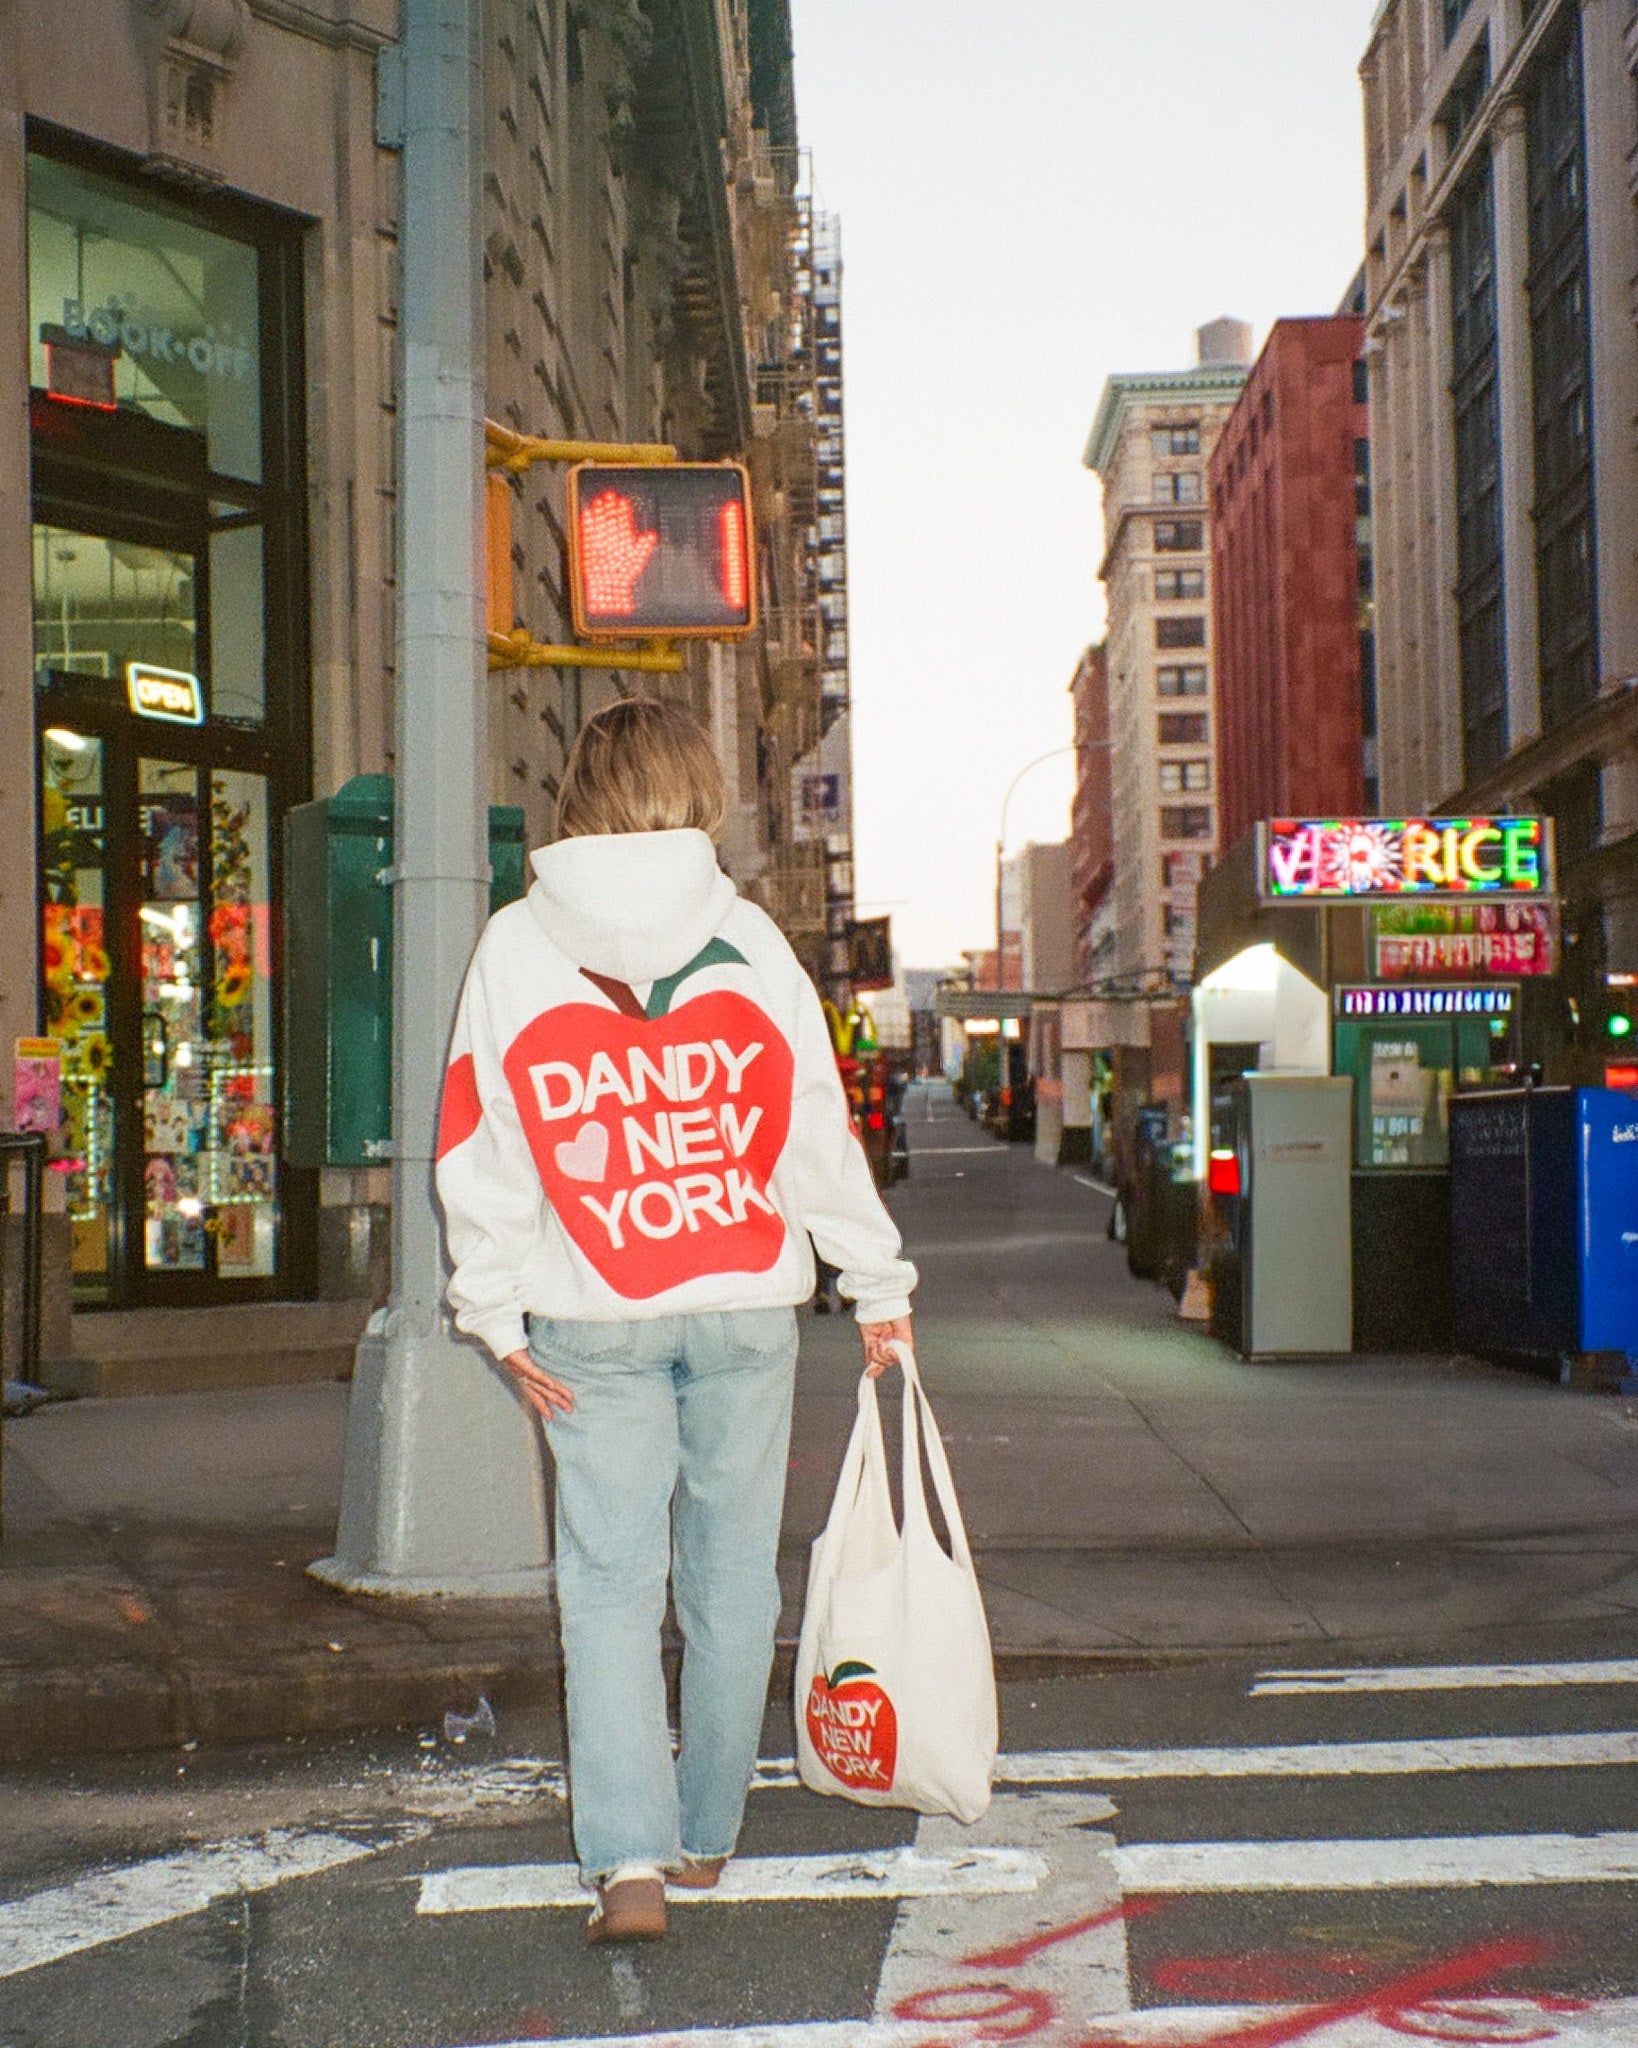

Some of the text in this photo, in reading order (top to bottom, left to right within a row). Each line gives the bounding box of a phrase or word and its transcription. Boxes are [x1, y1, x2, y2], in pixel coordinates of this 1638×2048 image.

[136, 678, 192, 712] OPEN
[527, 1038, 765, 1122] DANDY
[621, 1102, 764, 1175] NEW
[579, 1168, 777, 1250] YORK
[809, 1689, 883, 1728] DANDY
[820, 1721, 872, 1756] NEW
